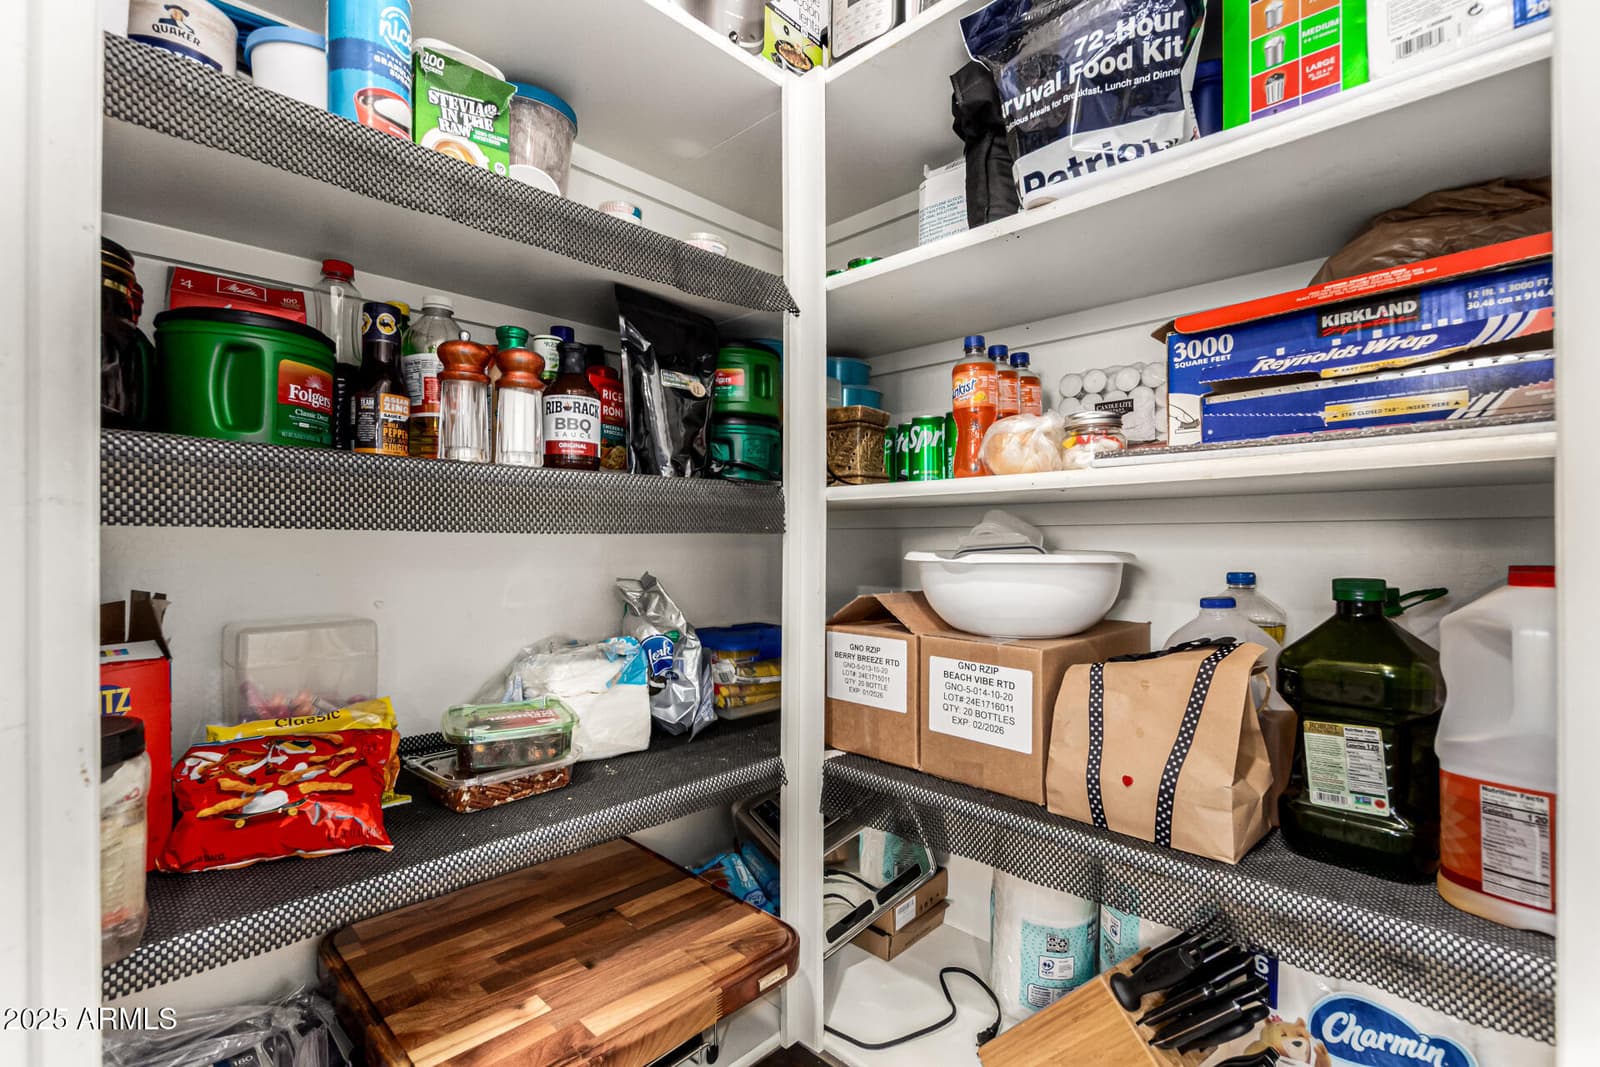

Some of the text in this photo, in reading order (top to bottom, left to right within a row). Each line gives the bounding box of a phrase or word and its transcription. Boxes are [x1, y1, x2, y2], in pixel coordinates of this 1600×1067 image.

[152, 23, 201, 47] QUAKER
[1074, 9, 1185, 57] 72-Hour
[1302, 18, 1339, 38] MEDIUM
[423, 52, 445, 70] 100
[1069, 45, 1133, 85] Food
[1142, 35, 1184, 66] Kit
[1306, 56, 1336, 73] LARGE
[428, 90, 486, 117] STEVIA
[1030, 104, 1051, 120] Meals
[1052, 99, 1062, 109] for
[1105, 78, 1132, 92] Lunch
[1133, 74, 1150, 87] and
[441, 107, 459, 124] IN
[438, 117, 471, 138] RAW
[1467, 290, 1479, 299] 12
[1481, 287, 1496, 296] IN.
[1508, 280, 1535, 292] 3000
[1536, 278, 1553, 287] FT.
[1466, 298, 1495, 310] 30.48
[1496, 294, 1513, 305] cm
[1320, 300, 1418, 328] KIRKLAND
[1173, 334, 1234, 363] 3000
[1250, 333, 1439, 373] Reynolds Wrap
[1174, 354, 1232, 369] SQUARE FEET
[287, 384, 331, 408] Folgers
[602, 388, 623, 402] RICE
[545, 400, 600, 420] RIB RACK
[602, 405, 623, 418] RONI
[1357, 408, 1383, 417] CLOSED
[555, 417, 592, 434] BBQ
[555, 431, 592, 439] SAUCE
[849, 643, 881, 654] GNO RZIP
[834, 651, 900, 667] BERRY BREEZE RTD
[957, 661, 999, 675] GNO RZIP
[943, 670, 1016, 690] BEACH VIBE RTD
[100, 687, 132, 714] TZ
[944, 681, 1014, 701] GNO-5-014-10-20
[943, 692, 1014, 713] LOT# 24E1716011
[274, 710, 341, 728] Classic
[963, 707, 973, 716] 20
[974, 709, 1016, 725] BOTTLES
[972, 720, 1005, 735] 02/2026
[1482, 786, 1545, 803] Nutrition Facts
[1482, 806, 1548, 825] Calories 120
[1321, 1012, 1446, 1062] Charmin
